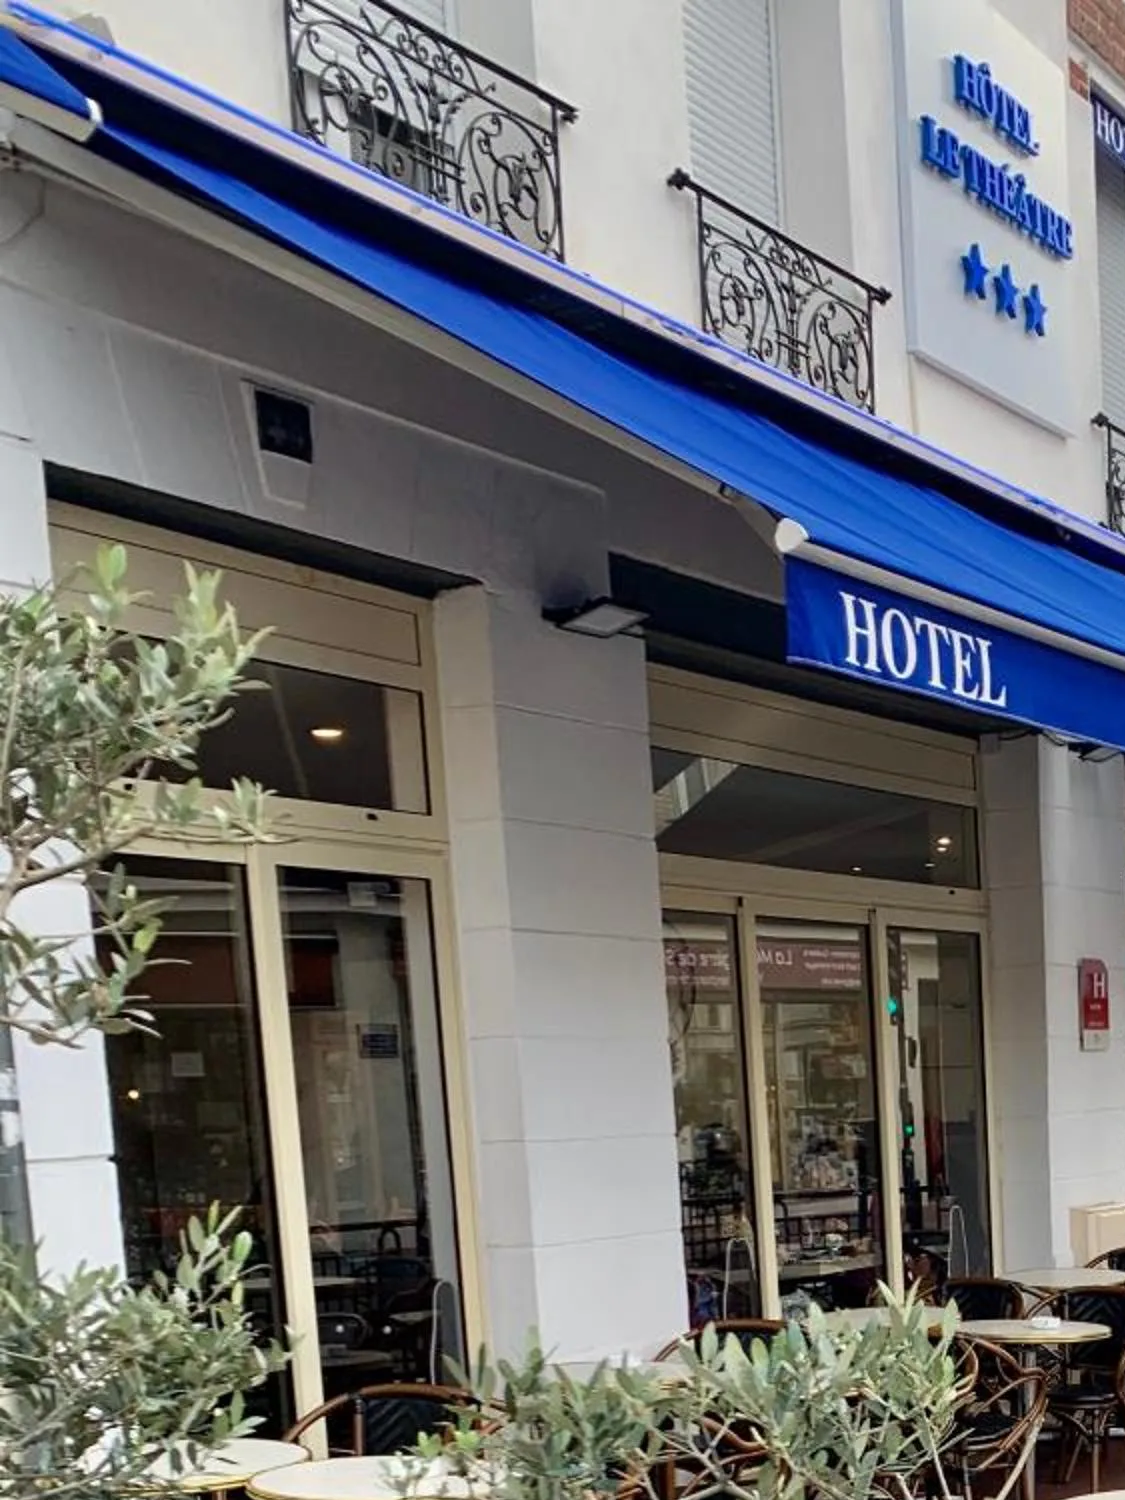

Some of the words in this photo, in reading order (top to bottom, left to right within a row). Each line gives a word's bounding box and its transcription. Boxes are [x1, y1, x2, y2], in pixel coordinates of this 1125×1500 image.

[919, 114, 961, 179] LE
[953, 54, 1040, 156] HÔTEL
[839, 590, 1008, 708] HOTEL
[1093, 972, 1106, 999] H
